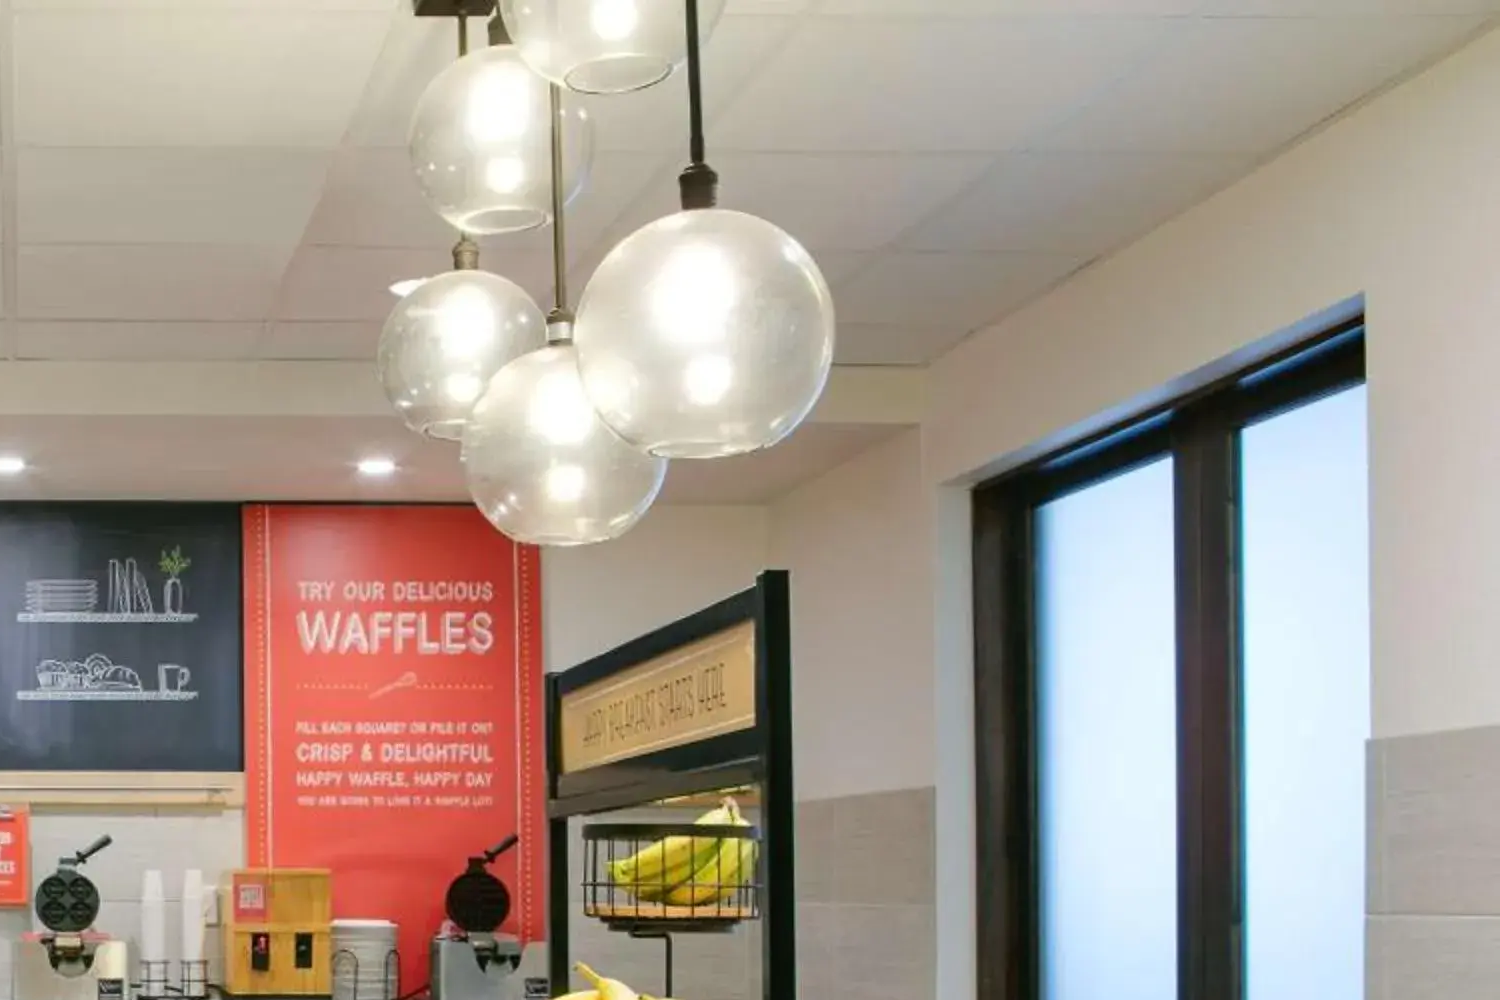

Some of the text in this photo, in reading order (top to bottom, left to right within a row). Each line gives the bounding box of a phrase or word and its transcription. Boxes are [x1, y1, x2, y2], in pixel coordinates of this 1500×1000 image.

[296, 580, 494, 603] TRY OUR DELICIOUS
[295, 609, 495, 656] WAFFLES
[659, 674, 695, 727] STARTS
[697, 662, 727, 715] HERE
[295, 740, 494, 763] CRISP & DELIGHTFUL
[296, 771, 493, 788] HAPPY WAFFLE, HAPPY DAY
